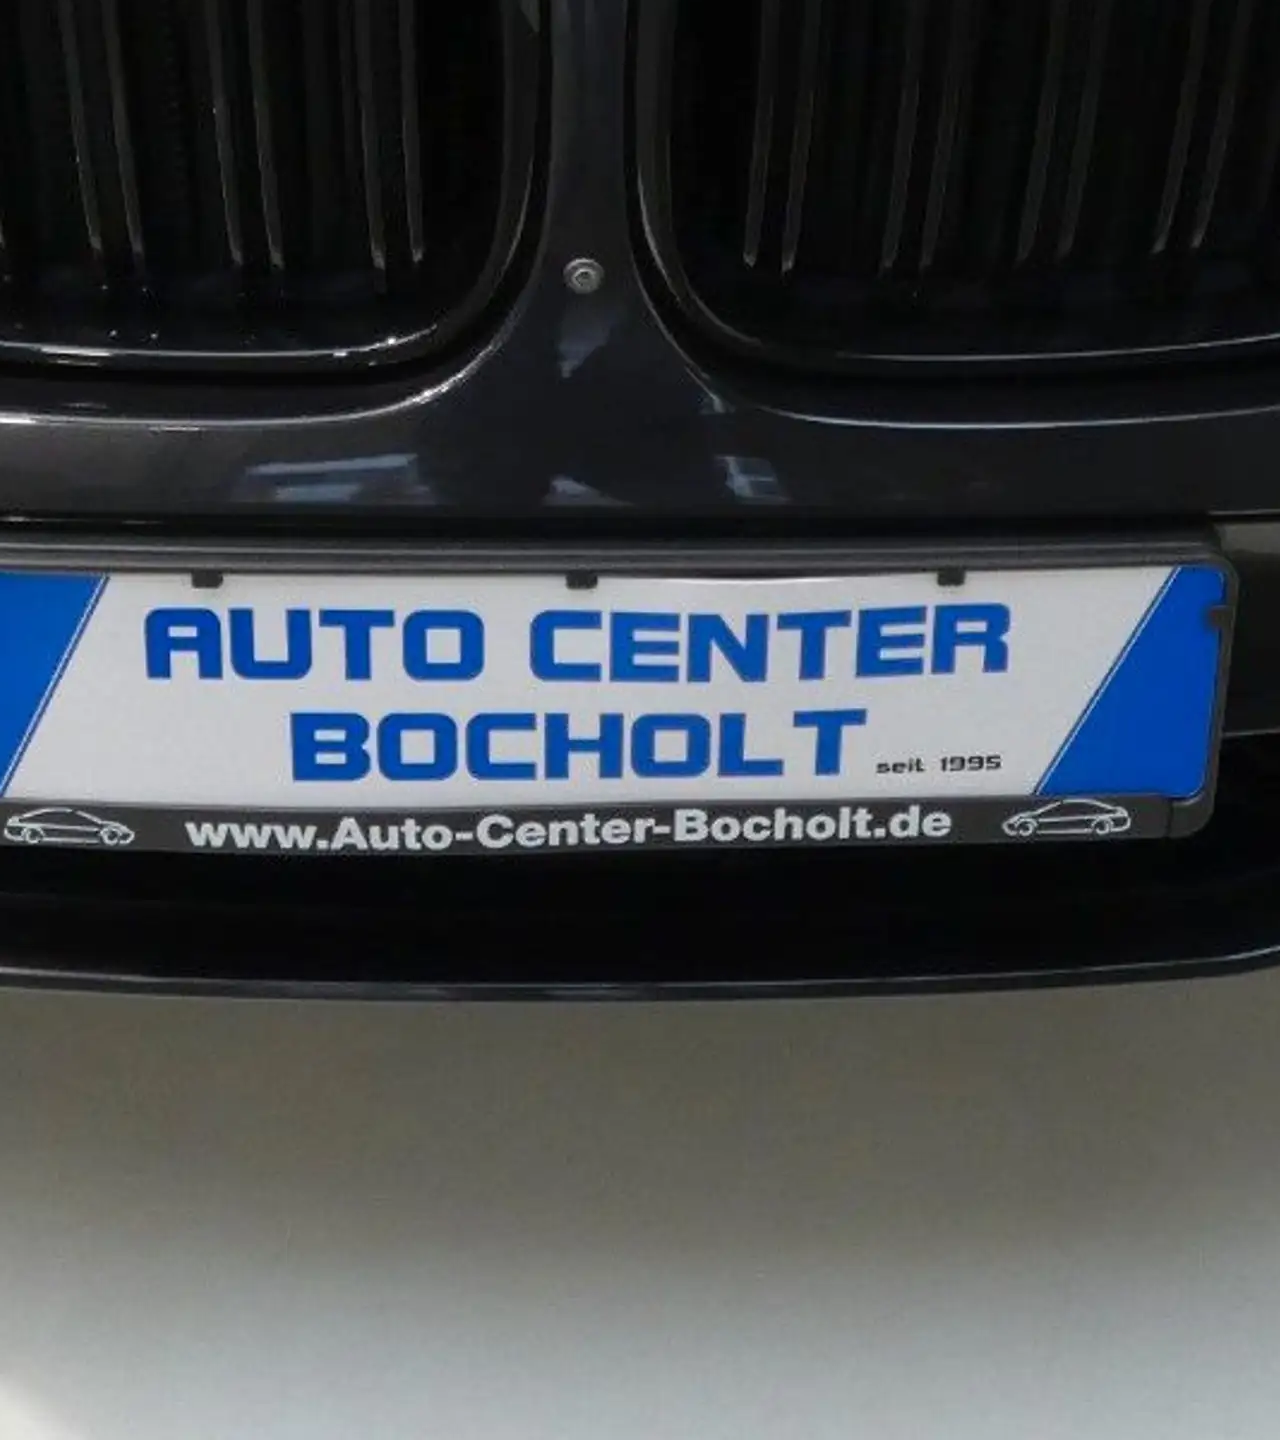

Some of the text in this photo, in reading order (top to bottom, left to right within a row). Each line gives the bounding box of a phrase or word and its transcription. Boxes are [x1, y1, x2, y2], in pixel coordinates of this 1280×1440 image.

[144, 601, 1012, 685] AUTO CENTER
[290, 707, 1002, 783] BOCHOLT seit 1995
[184, 804, 952, 852] www.Auto-Center-Bocholt.de
